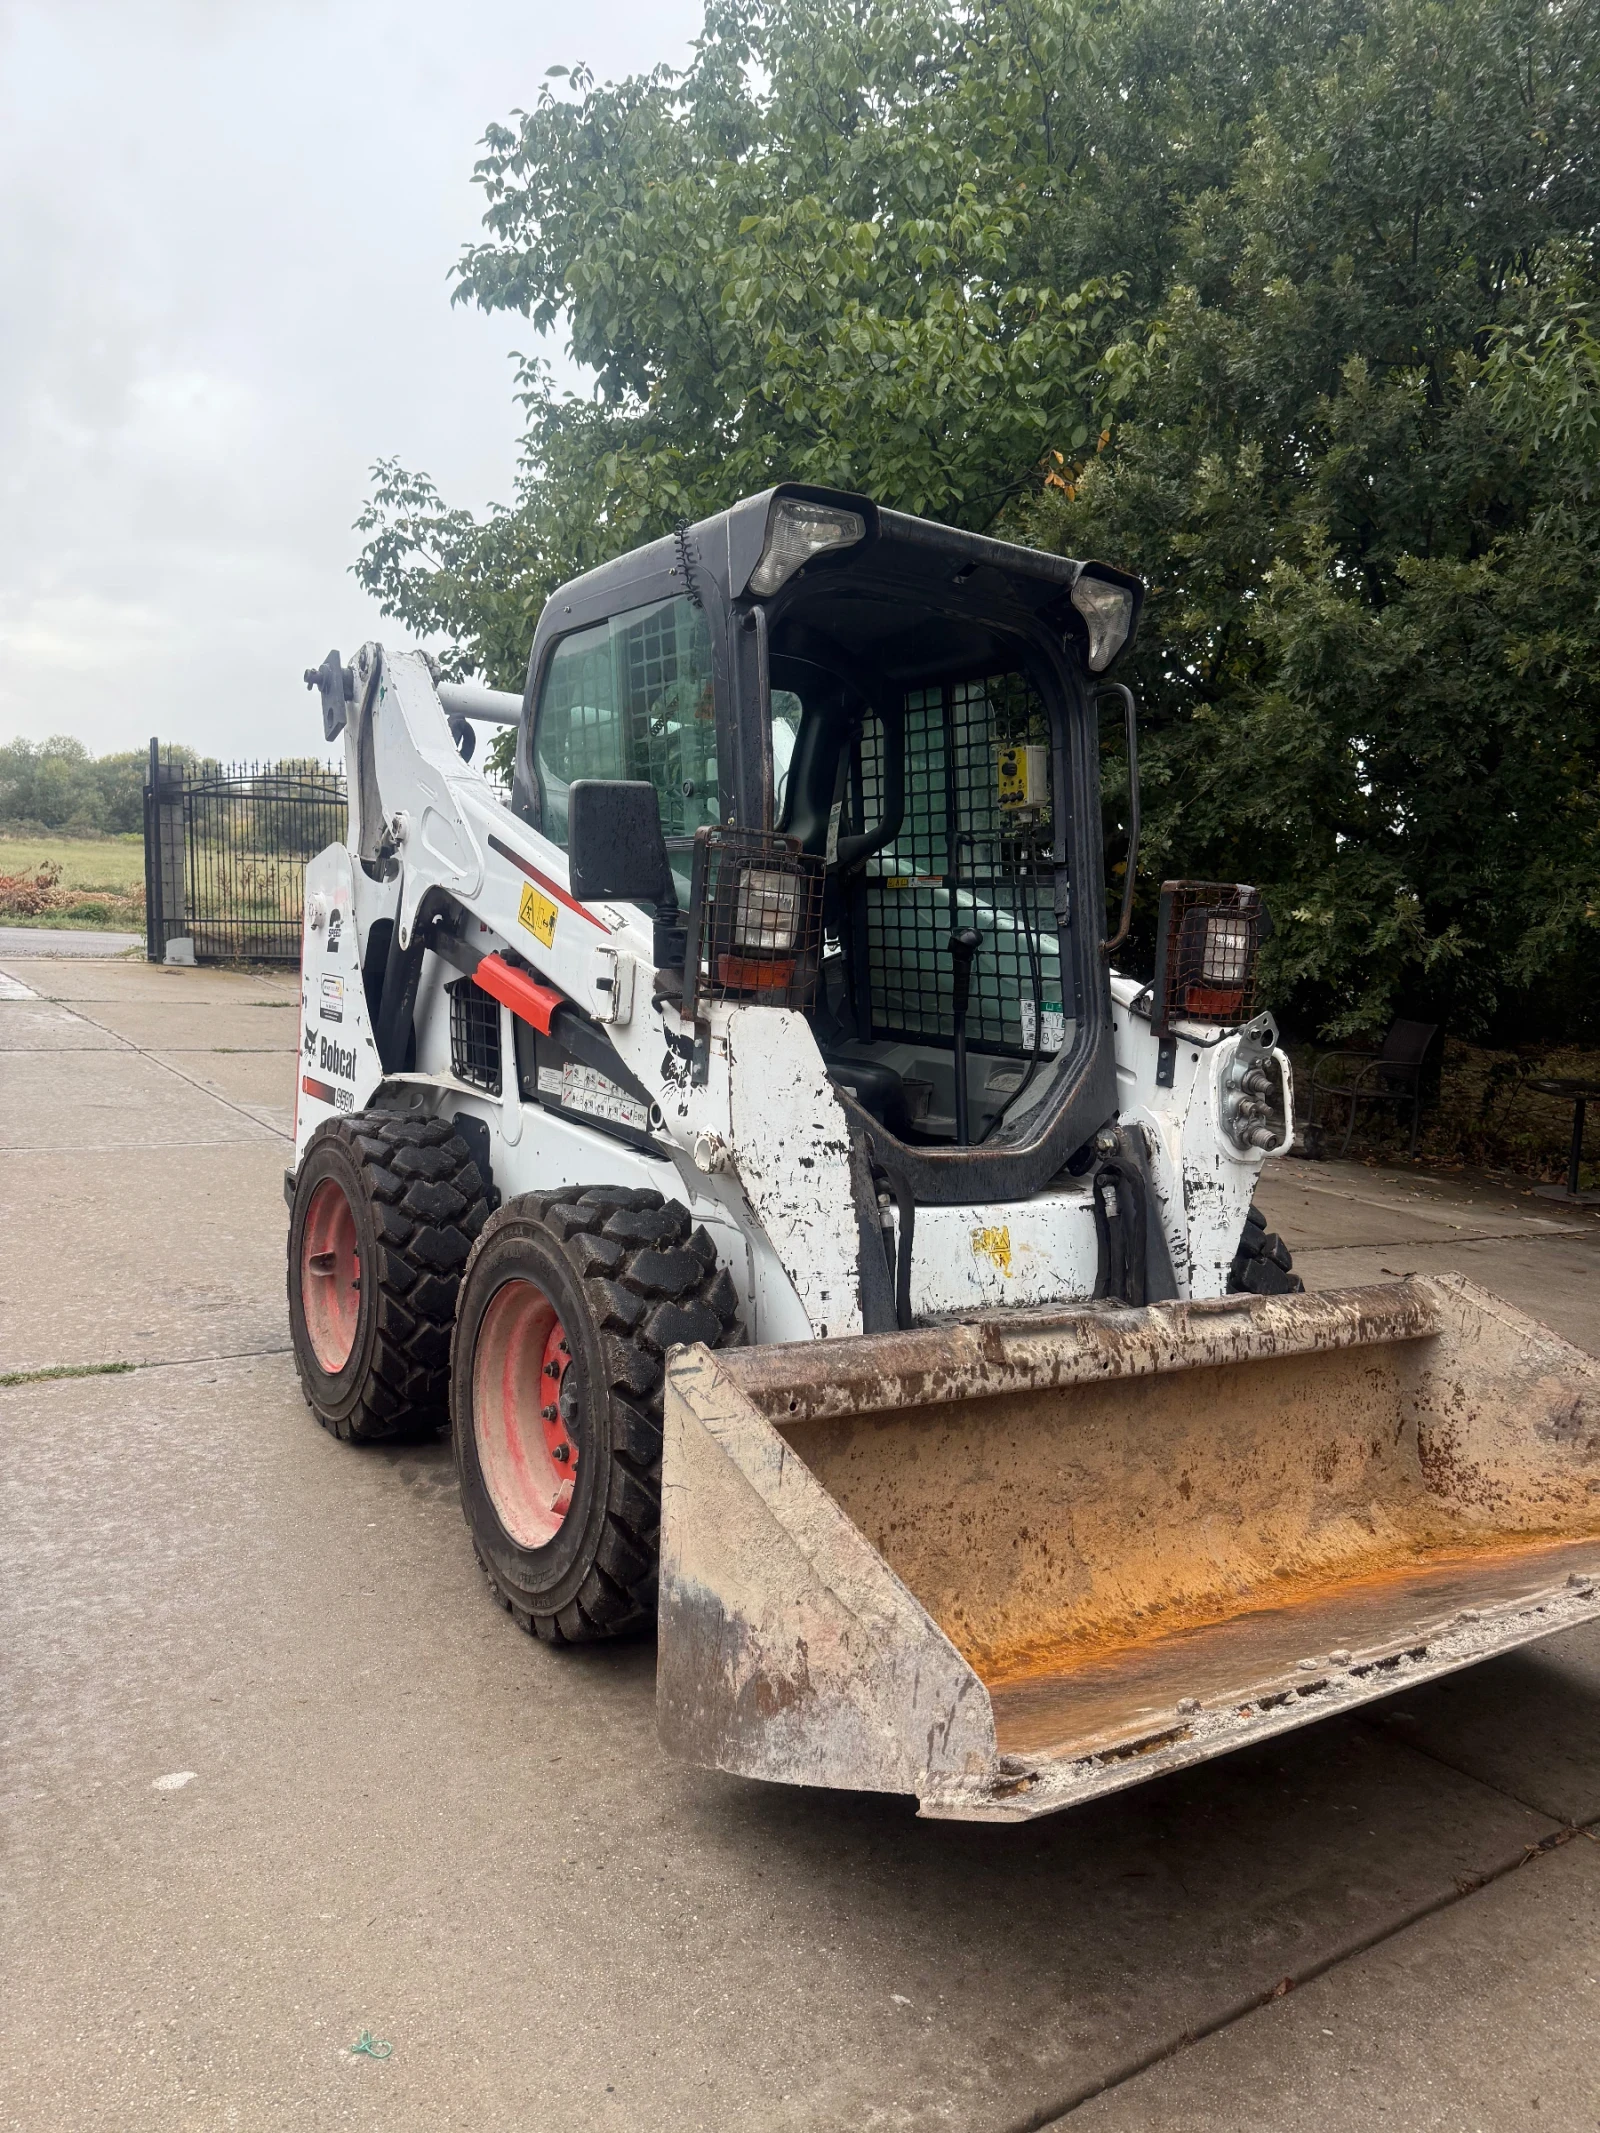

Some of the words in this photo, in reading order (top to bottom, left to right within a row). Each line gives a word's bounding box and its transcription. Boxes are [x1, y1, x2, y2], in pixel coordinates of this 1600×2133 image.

[328, 928, 341, 937] SPEED
[320, 1036, 357, 1082] Bobcat
[336, 1088, 355, 1114] S590
